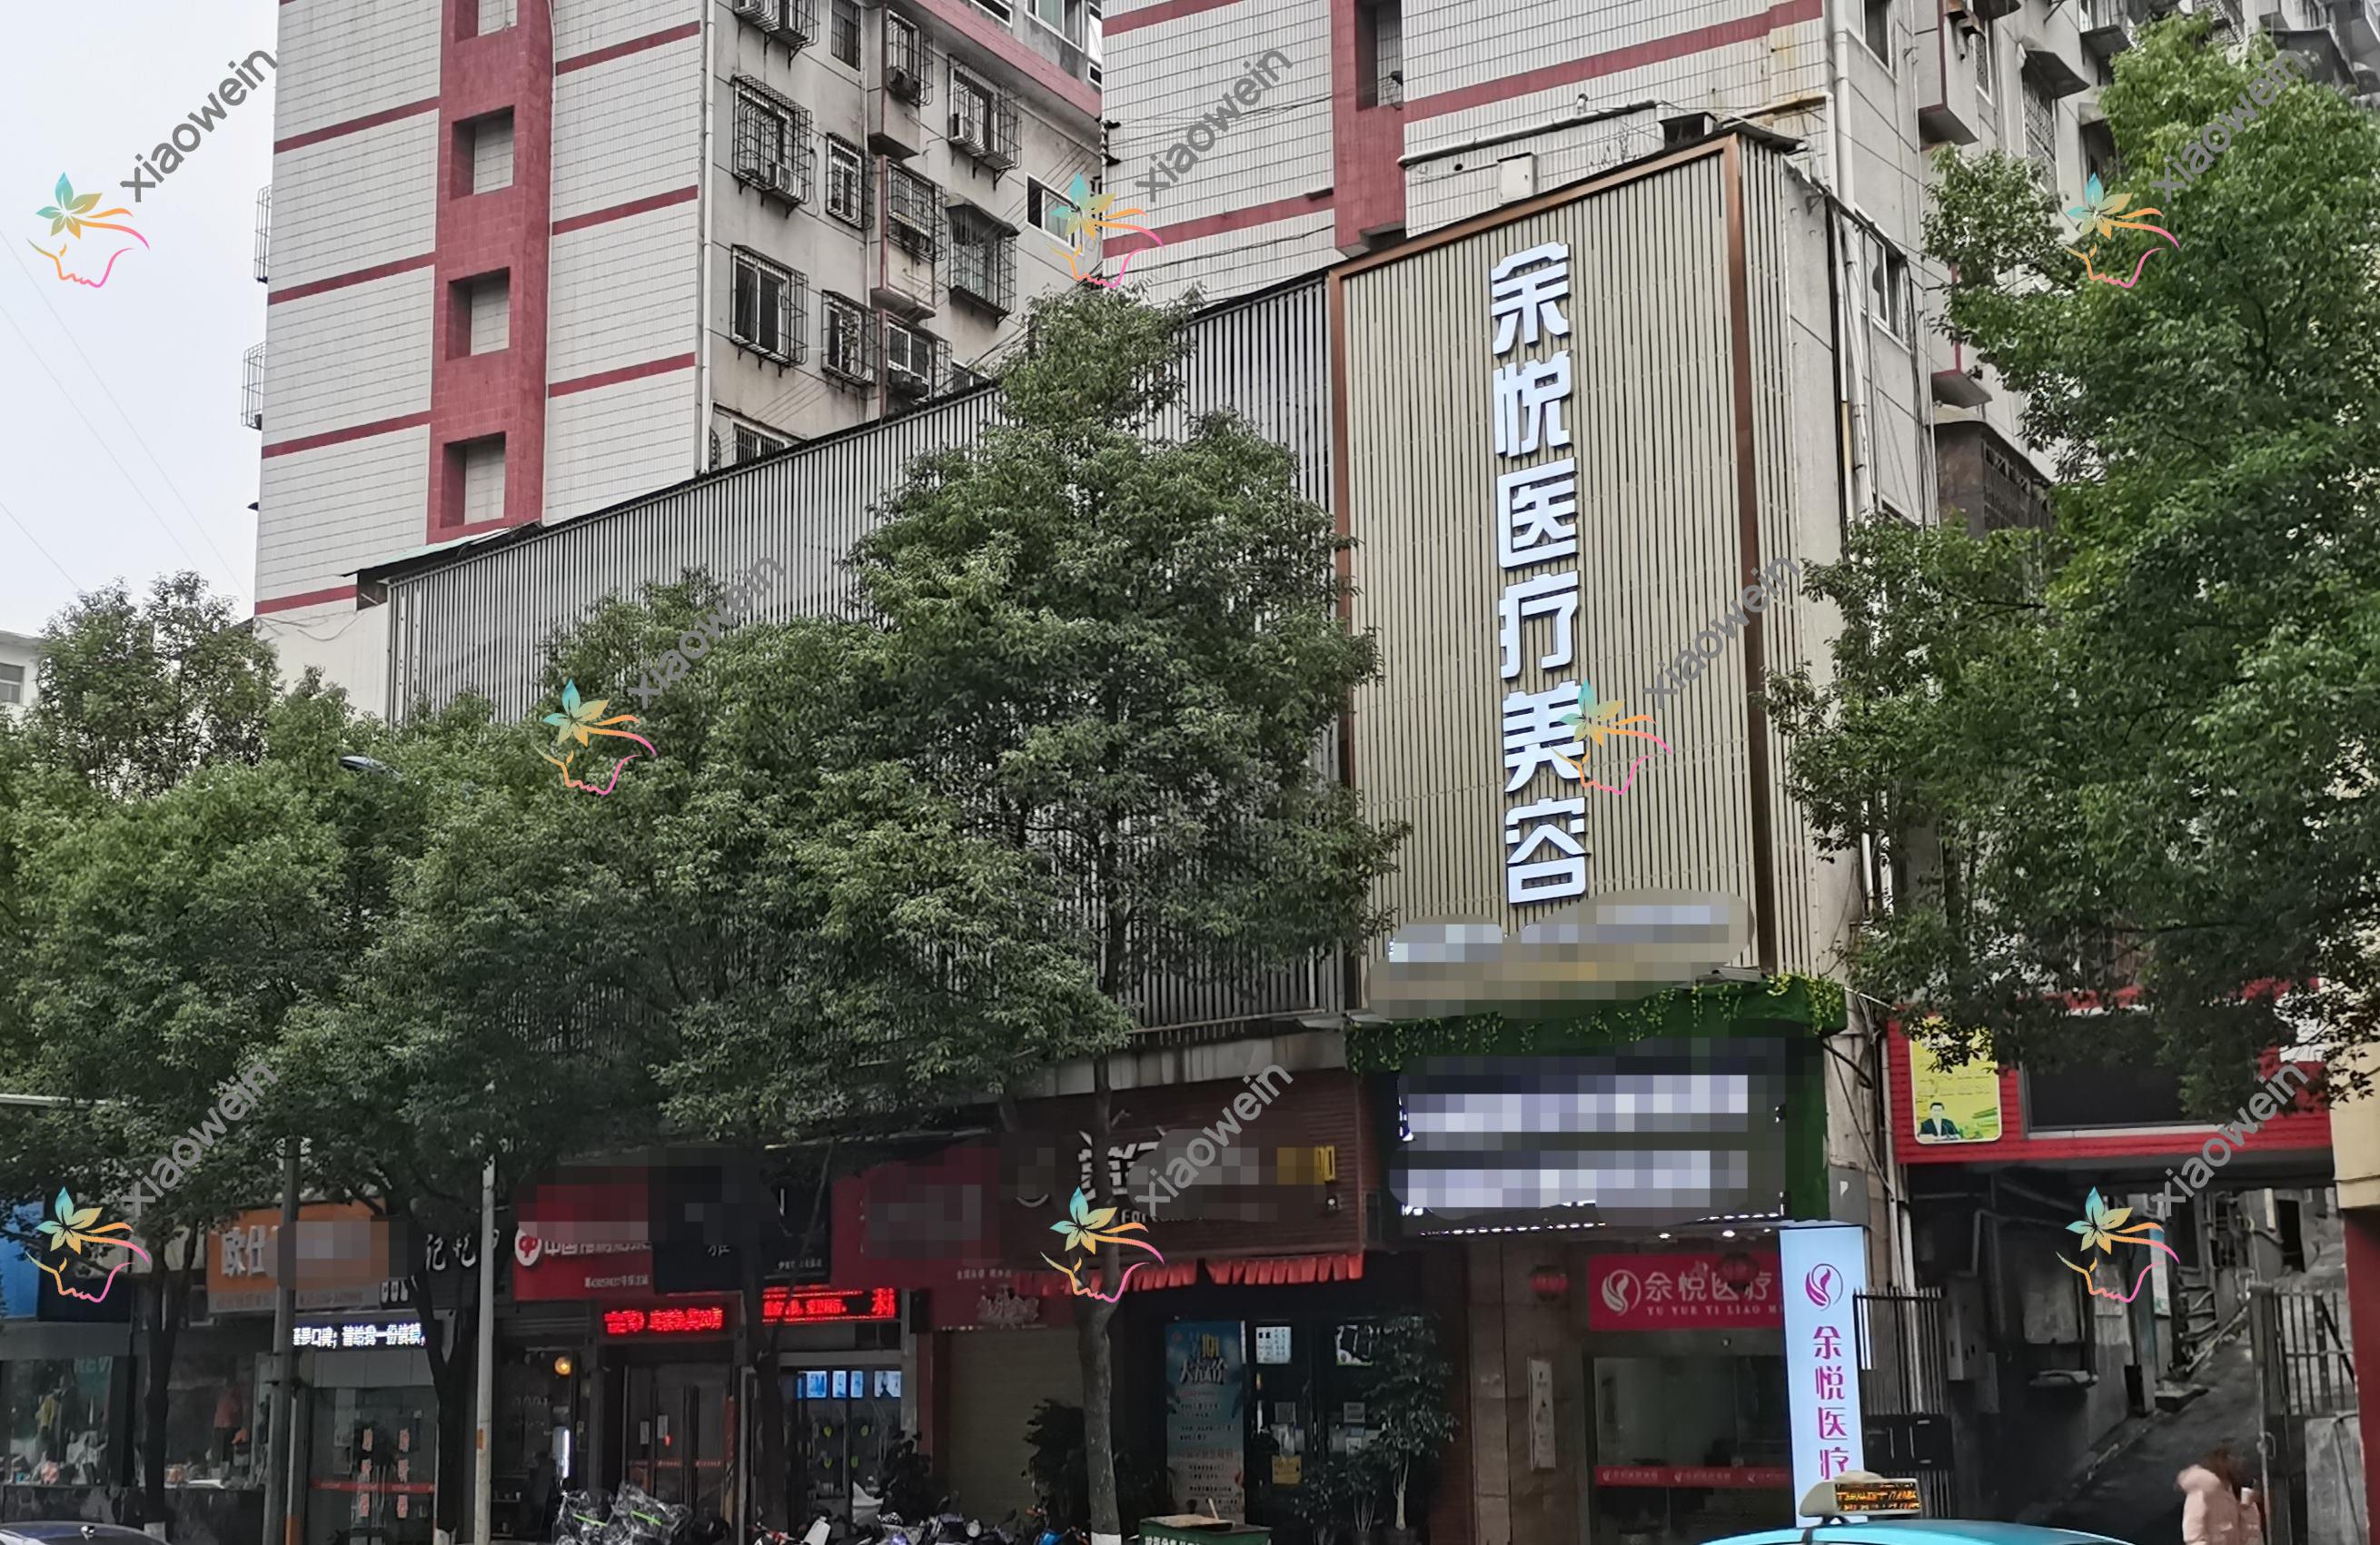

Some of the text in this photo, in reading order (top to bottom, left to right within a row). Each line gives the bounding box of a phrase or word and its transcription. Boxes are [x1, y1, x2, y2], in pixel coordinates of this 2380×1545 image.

[1490, 240, 1591, 905] 余悦医疗美容
[1813, 1326, 1849, 1480] 余悦医疗
